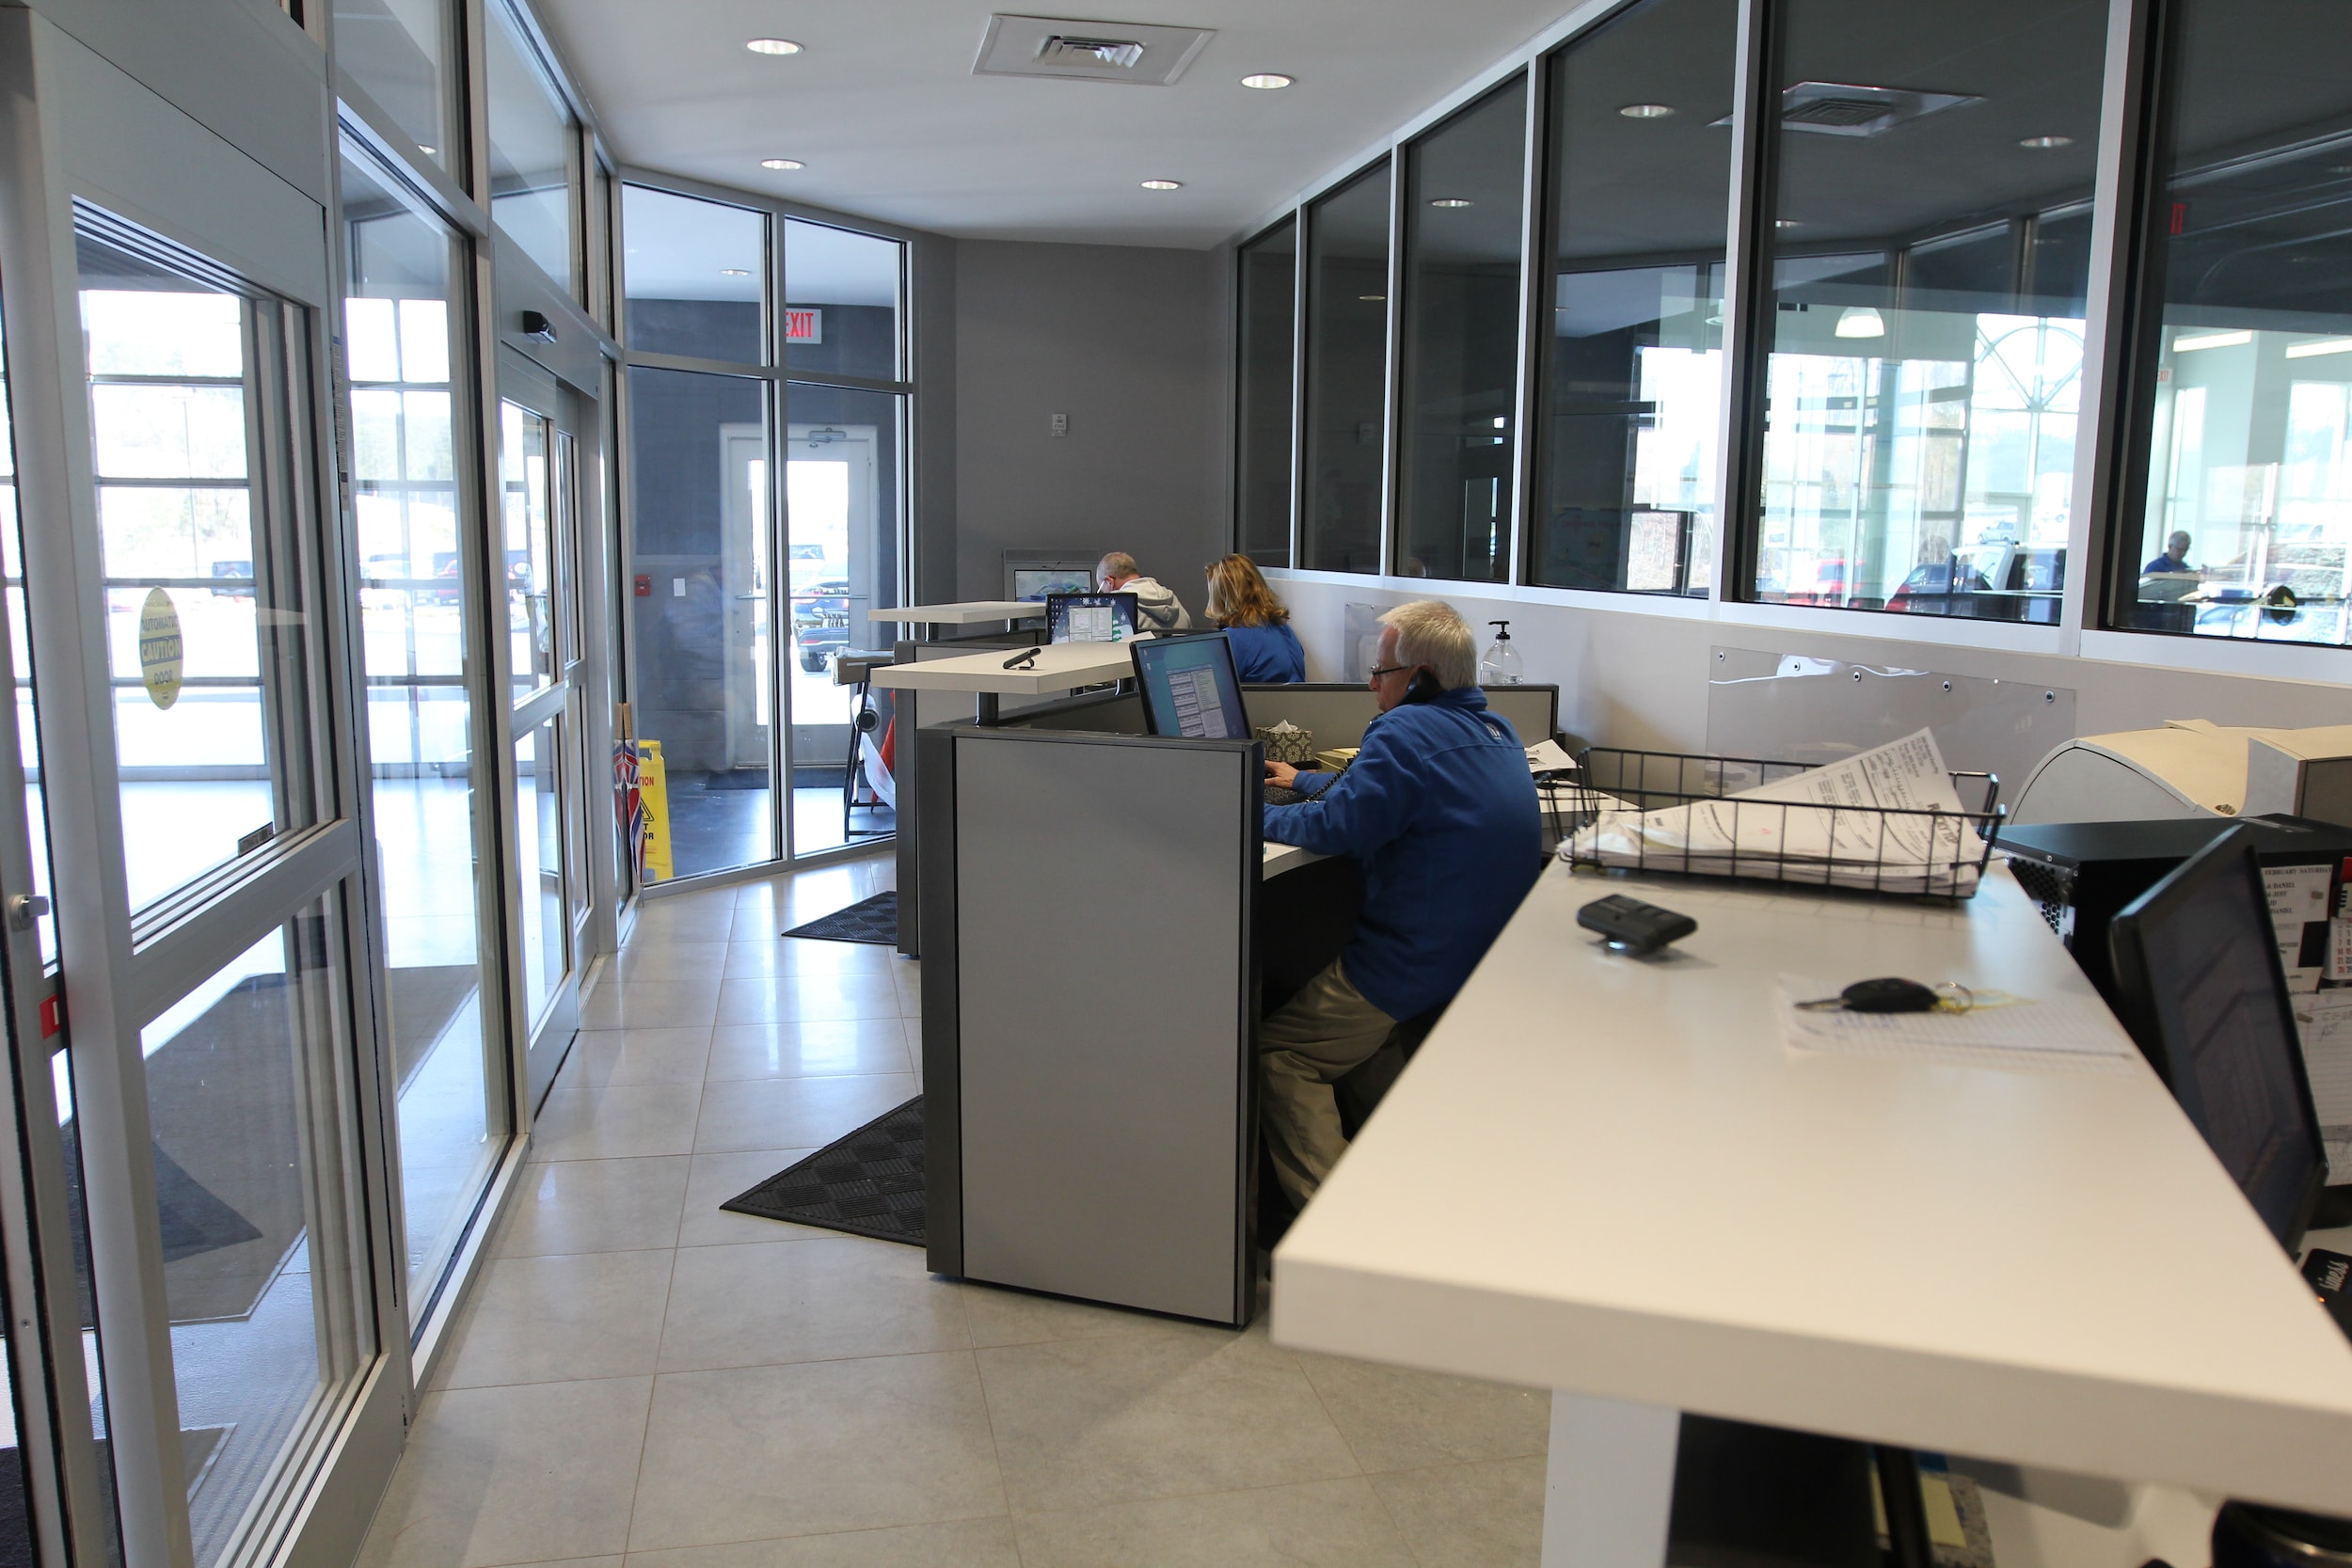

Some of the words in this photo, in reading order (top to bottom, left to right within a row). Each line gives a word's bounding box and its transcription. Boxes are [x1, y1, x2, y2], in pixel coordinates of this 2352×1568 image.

[141, 615, 179, 632] AUTOMATIC
[141, 639, 182, 663] CAUTION
[153, 670, 173, 686] DOOR
